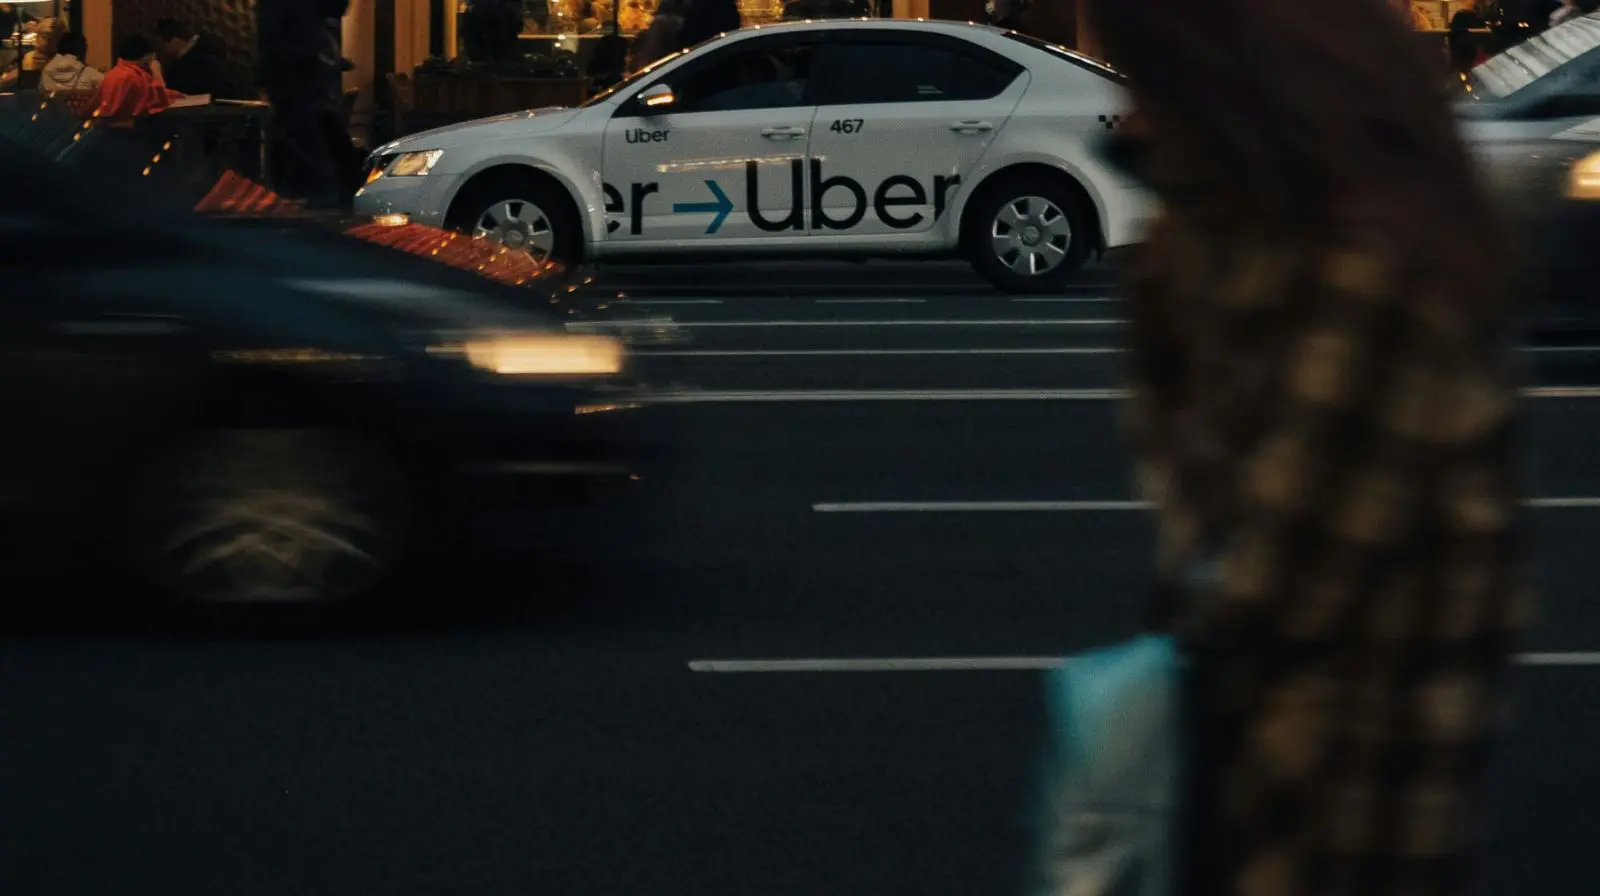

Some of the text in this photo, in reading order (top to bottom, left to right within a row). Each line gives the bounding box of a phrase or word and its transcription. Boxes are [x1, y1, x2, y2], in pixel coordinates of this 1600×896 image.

[830, 118, 865, 134] 467
[624, 128, 670, 144] Uber
[746, 158, 961, 232] Uber
